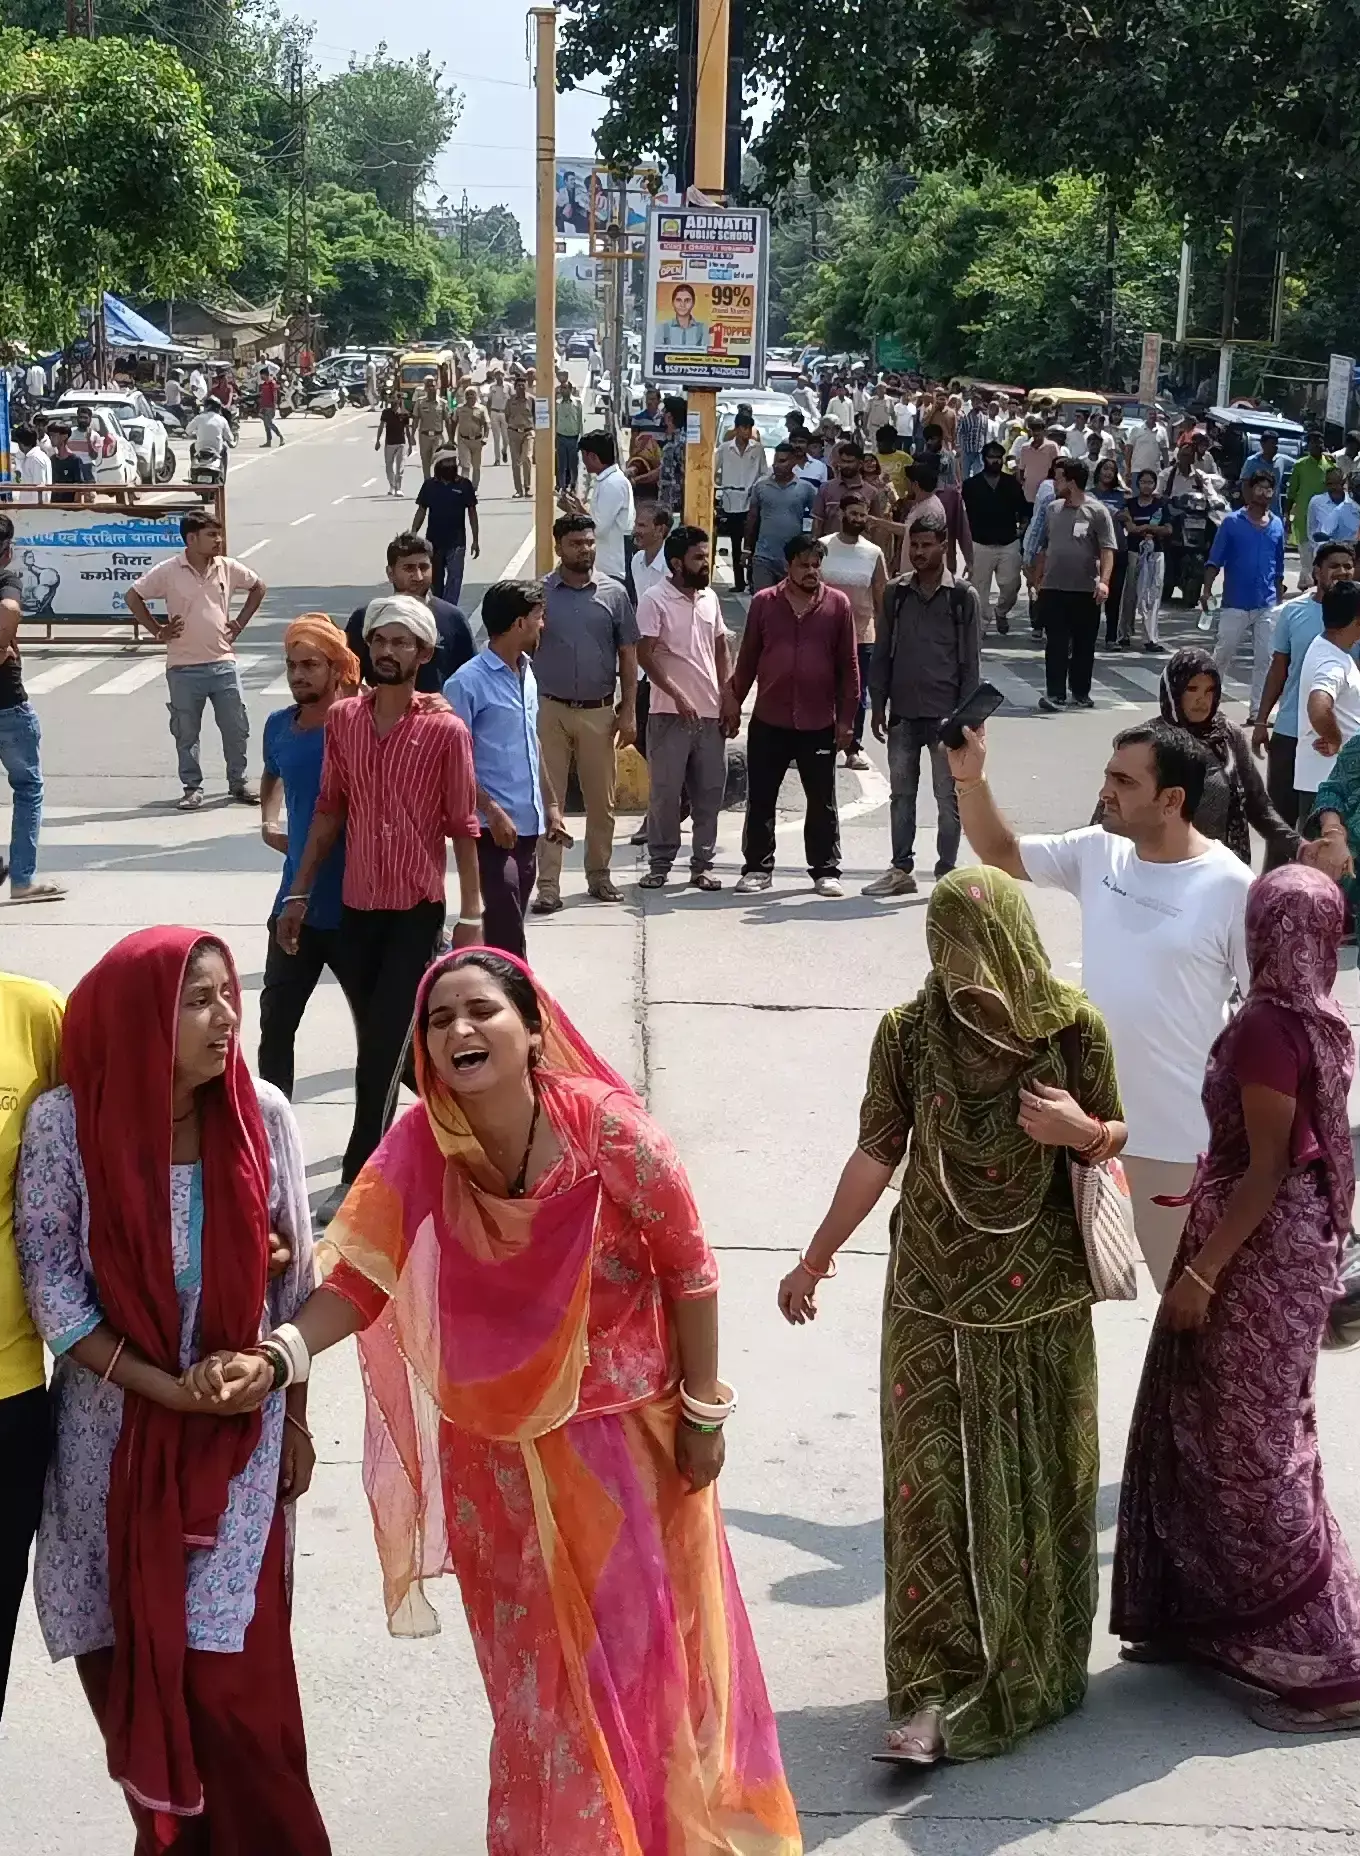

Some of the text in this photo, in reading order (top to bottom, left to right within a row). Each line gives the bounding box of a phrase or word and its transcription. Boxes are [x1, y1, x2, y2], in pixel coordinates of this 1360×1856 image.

[685, 215, 753, 231] ADINATH
[684, 229, 754, 242] PUBLIC SCHOOL
[660, 266, 683, 276] OPEN
[711, 285, 751, 307] 99%
[81, 529, 127, 546] सुरक्षित
